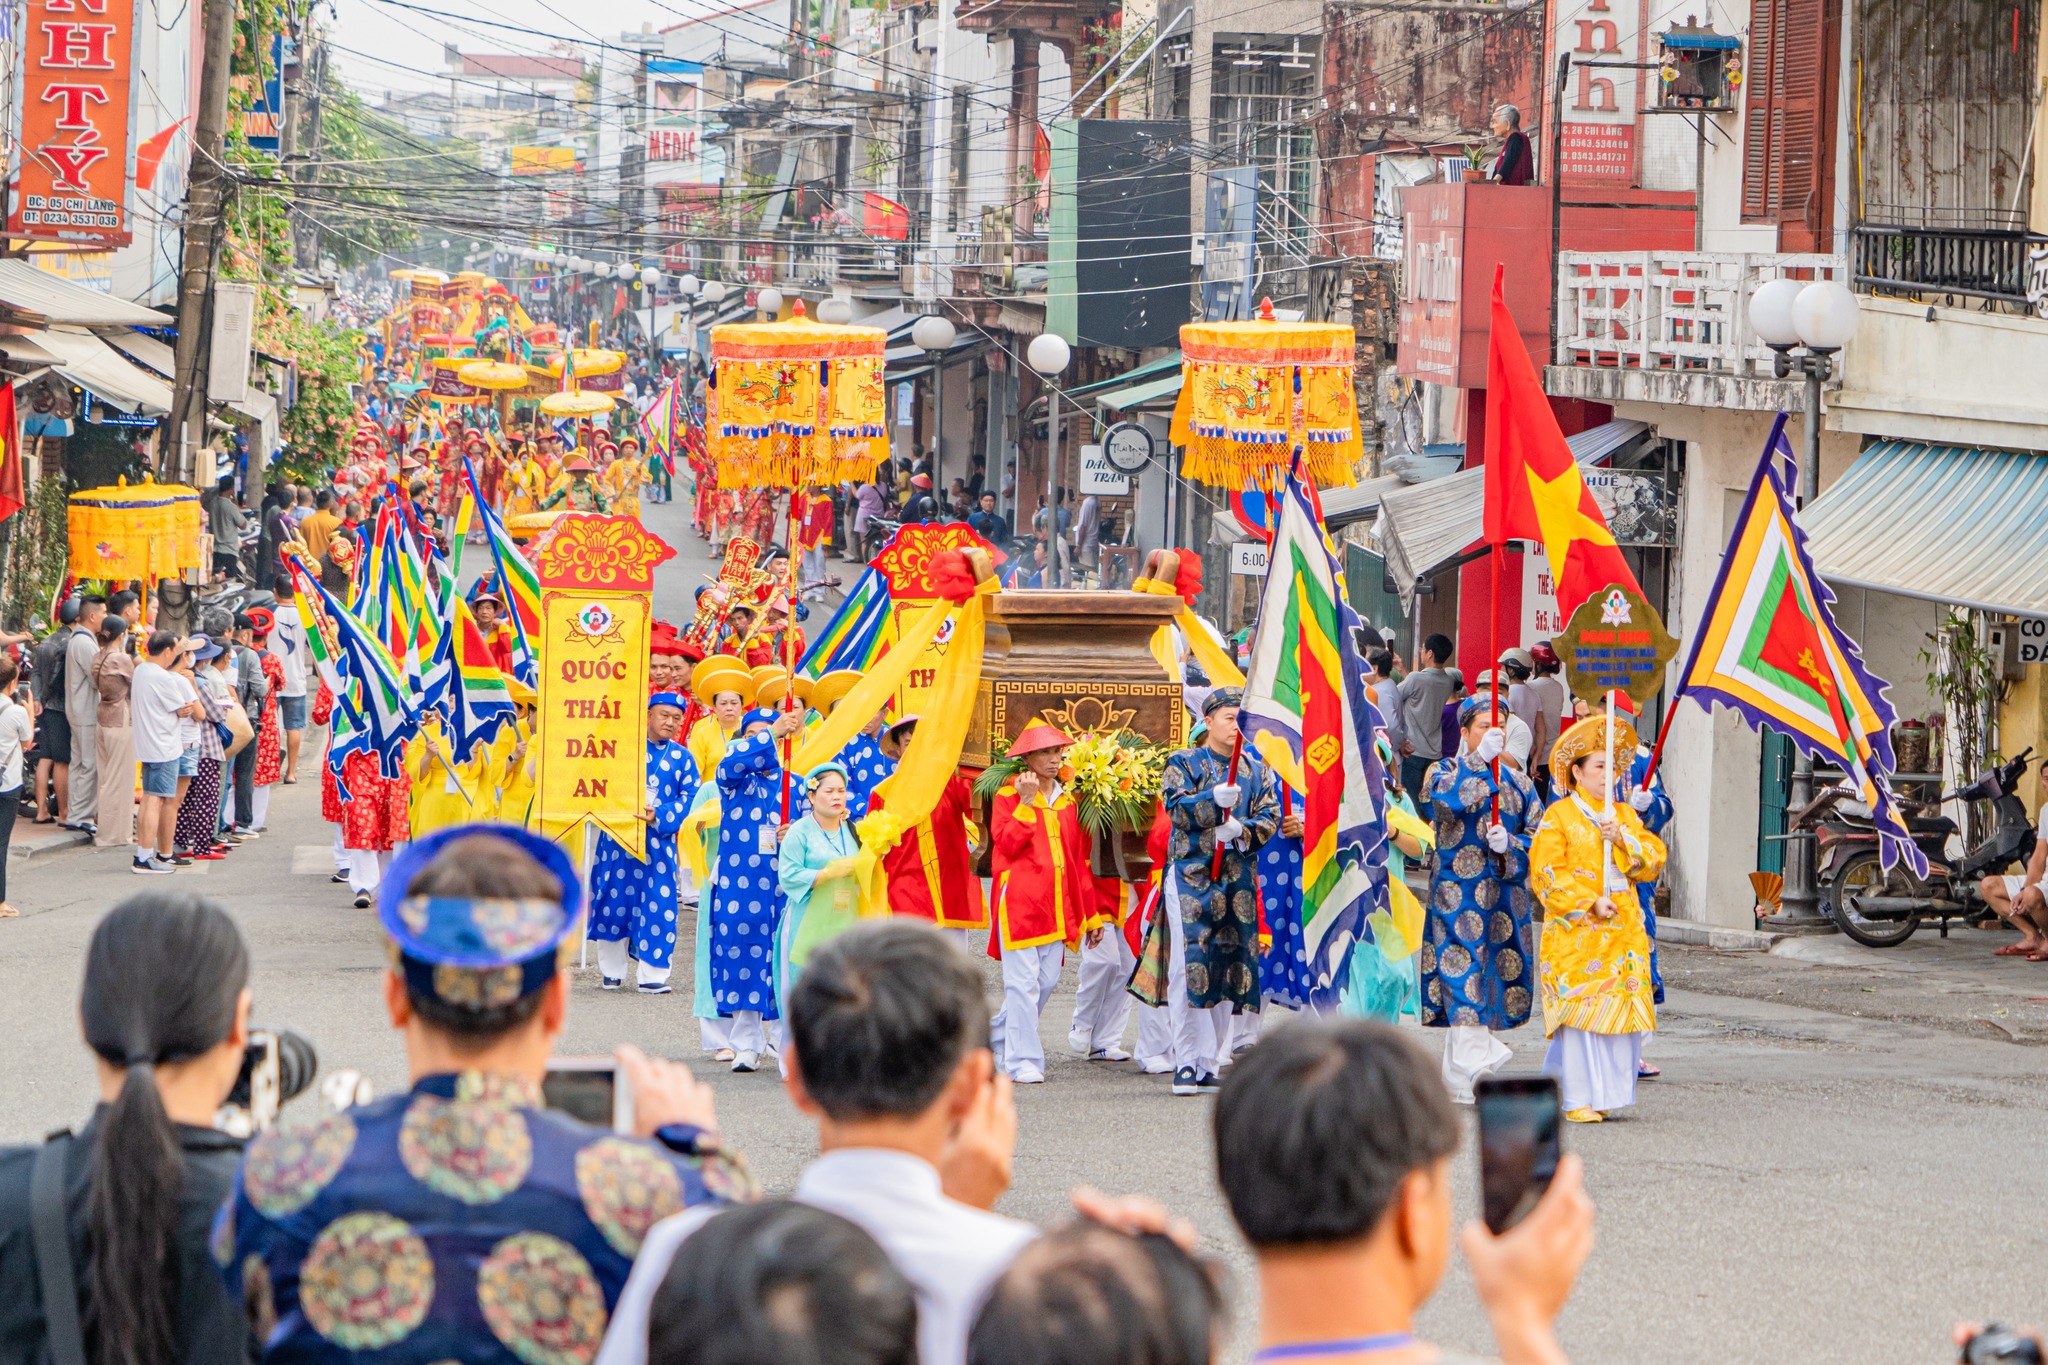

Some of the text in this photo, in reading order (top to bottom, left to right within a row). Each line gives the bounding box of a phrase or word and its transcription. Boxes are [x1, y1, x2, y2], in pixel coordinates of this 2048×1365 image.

[1585, 126, 1599, 136] CHI
[649, 131, 695, 162] MEDIC
[29, 197, 45, 207] ĐC:
[50, 198, 62, 208] 05
[66, 200, 83, 210] CHI
[24, 212, 117, 226] ĐT: 0234 3531 038
[561, 652, 627, 684] QUỐC
[564, 695, 621, 719] THÁI
[566, 734, 617, 758] DÂN
[573, 778, 608, 798] AN
